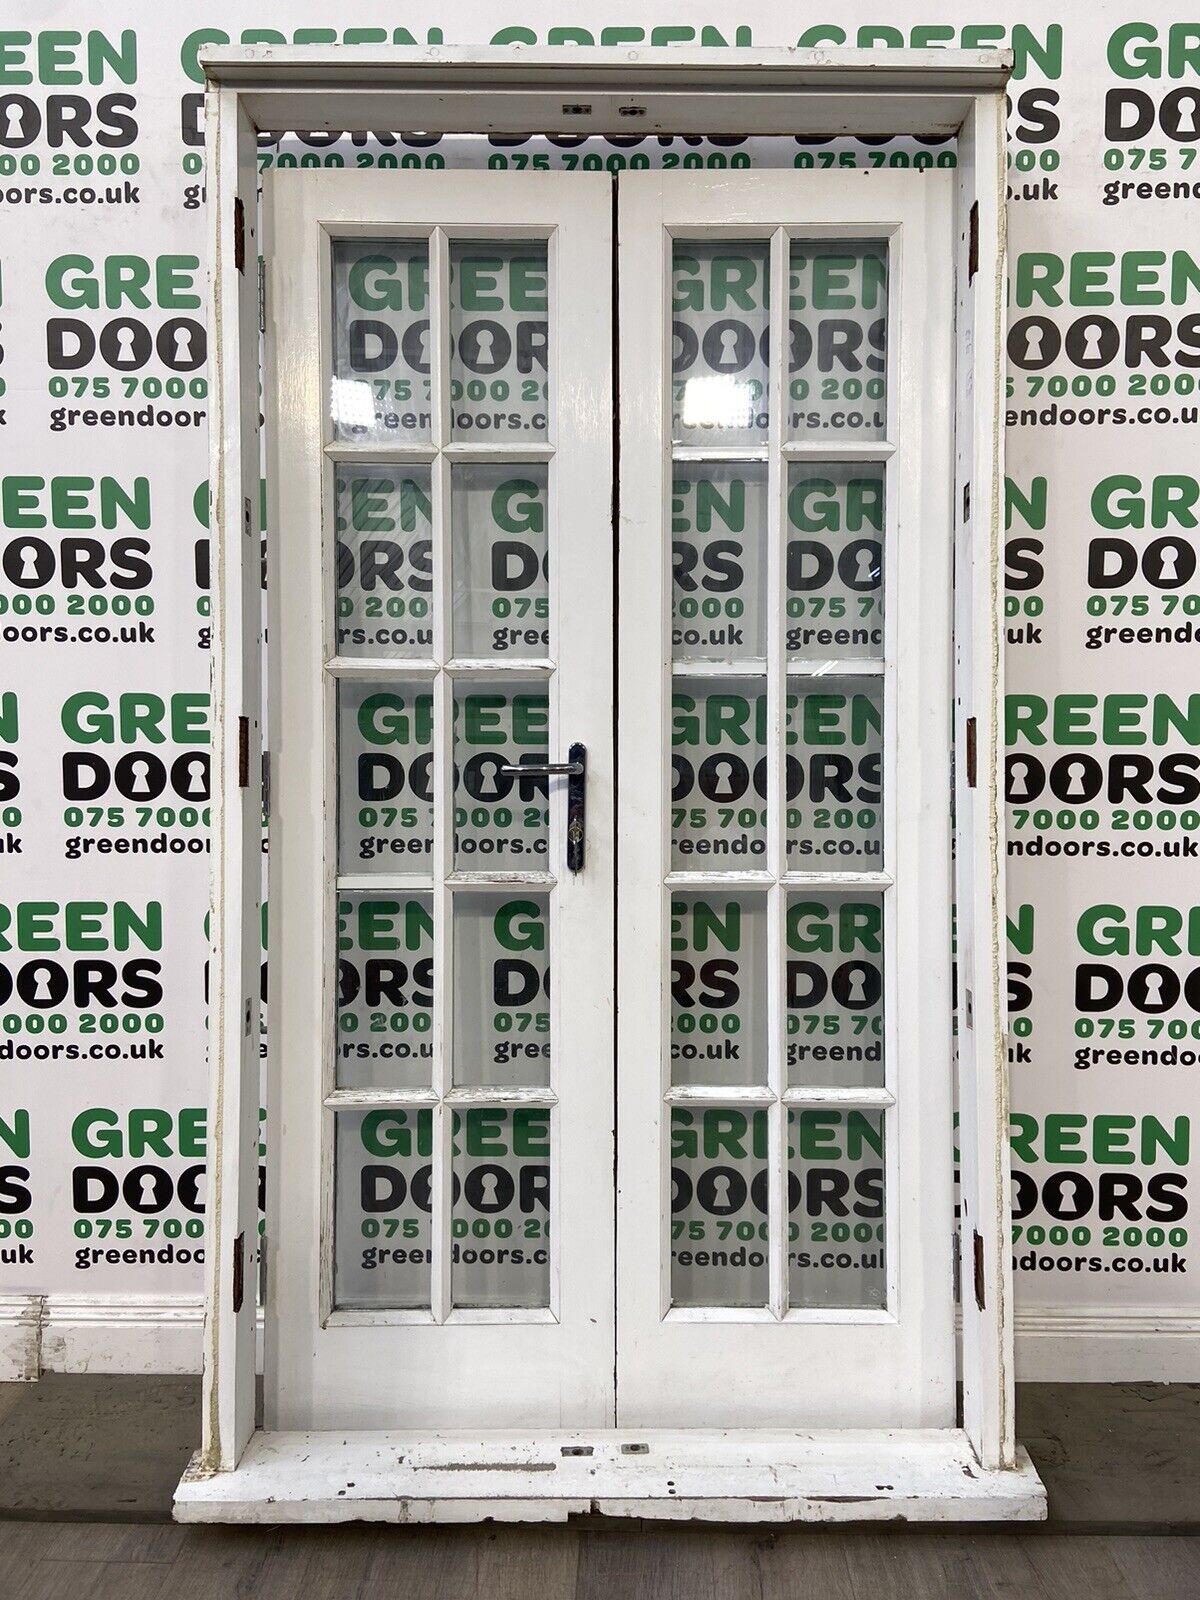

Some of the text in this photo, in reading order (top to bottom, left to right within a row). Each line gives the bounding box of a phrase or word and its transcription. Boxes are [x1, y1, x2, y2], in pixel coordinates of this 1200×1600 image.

[0, 29, 137, 85] EEN
[0, 93, 138, 148] ORS
[0, 154, 140, 175] 00 2000
[1104, 148, 1166, 170] 075
[45, 254, 201, 310] GRE
[349, 255, 548, 311] GREE
[1005, 250, 1200, 308] REEN
[46, 318, 207, 371] DOO
[350, 320, 548, 374] DOOR
[1007, 315, 1200, 371] OORS
[49, 377, 208, 399] 075 7000
[354, 379, 411, 400] 75
[423, 379, 509, 400] 000
[821, 378, 884, 400] 200
[1027, 375, 1200, 398] 7000 200
[50, 403, 206, 431] greendoor
[1005, 404, 1200, 427] endoors.co.u
[2, 476, 151, 530] EEN
[3, 537, 153, 590] ORS
[0, 595, 154, 616] 00 2000
[366, 597, 432, 618] 200
[491, 597, 548, 618] 075
[672, 597, 743, 618] 000
[786, 597, 845, 618] 075
[1087, 595, 1200, 617] 075 70
[3, 621, 154, 643] oors.co.uk
[61, 692, 210, 744] GRE
[357, 693, 549, 745] GREE
[1005, 694, 1200, 745] REEN
[63, 751, 210, 801] DOO
[358, 752, 549, 802] DOOR
[1005, 753, 1200, 804] OORS
[64, 807, 124, 827] 075
[358, 808, 512, 827] 075 000
[672, 808, 706, 828] 75
[813, 808, 876, 828] 200
[1013, 810, 1200, 830] 7000 2000
[1008, 836, 1198, 858] ndoors.co.uk
[0, 901, 163, 951] EEN
[0, 959, 163, 1009] ORS
[3, 1014, 164, 1034] 000 2000
[370, 1013, 431, 1032] 200
[494, 1013, 550, 1032] 075
[672, 1013, 740, 1033] 000
[1074, 1017, 1135, 1039] 075
[0, 1039, 164, 1060] doors.co.uk
[72, 1109, 207, 1158] GRE
[361, 1108, 550, 1157] GREE
[1010, 1113, 1190, 1165] REEN
[73, 1165, 206, 1214] DOO
[361, 1164, 550, 1213] DOOR
[1011, 1171, 1188, 1223] OORS
[0, 1219, 33, 1238] 00
[73, 1219, 203, 1239] 075 700
[361, 1218, 512, 1238] 075 000
[671, 1221, 705, 1240] 75
[1102, 1226, 1188, 1246] 2000
[1012, 1252, 1187, 1273] doors.co.uk
